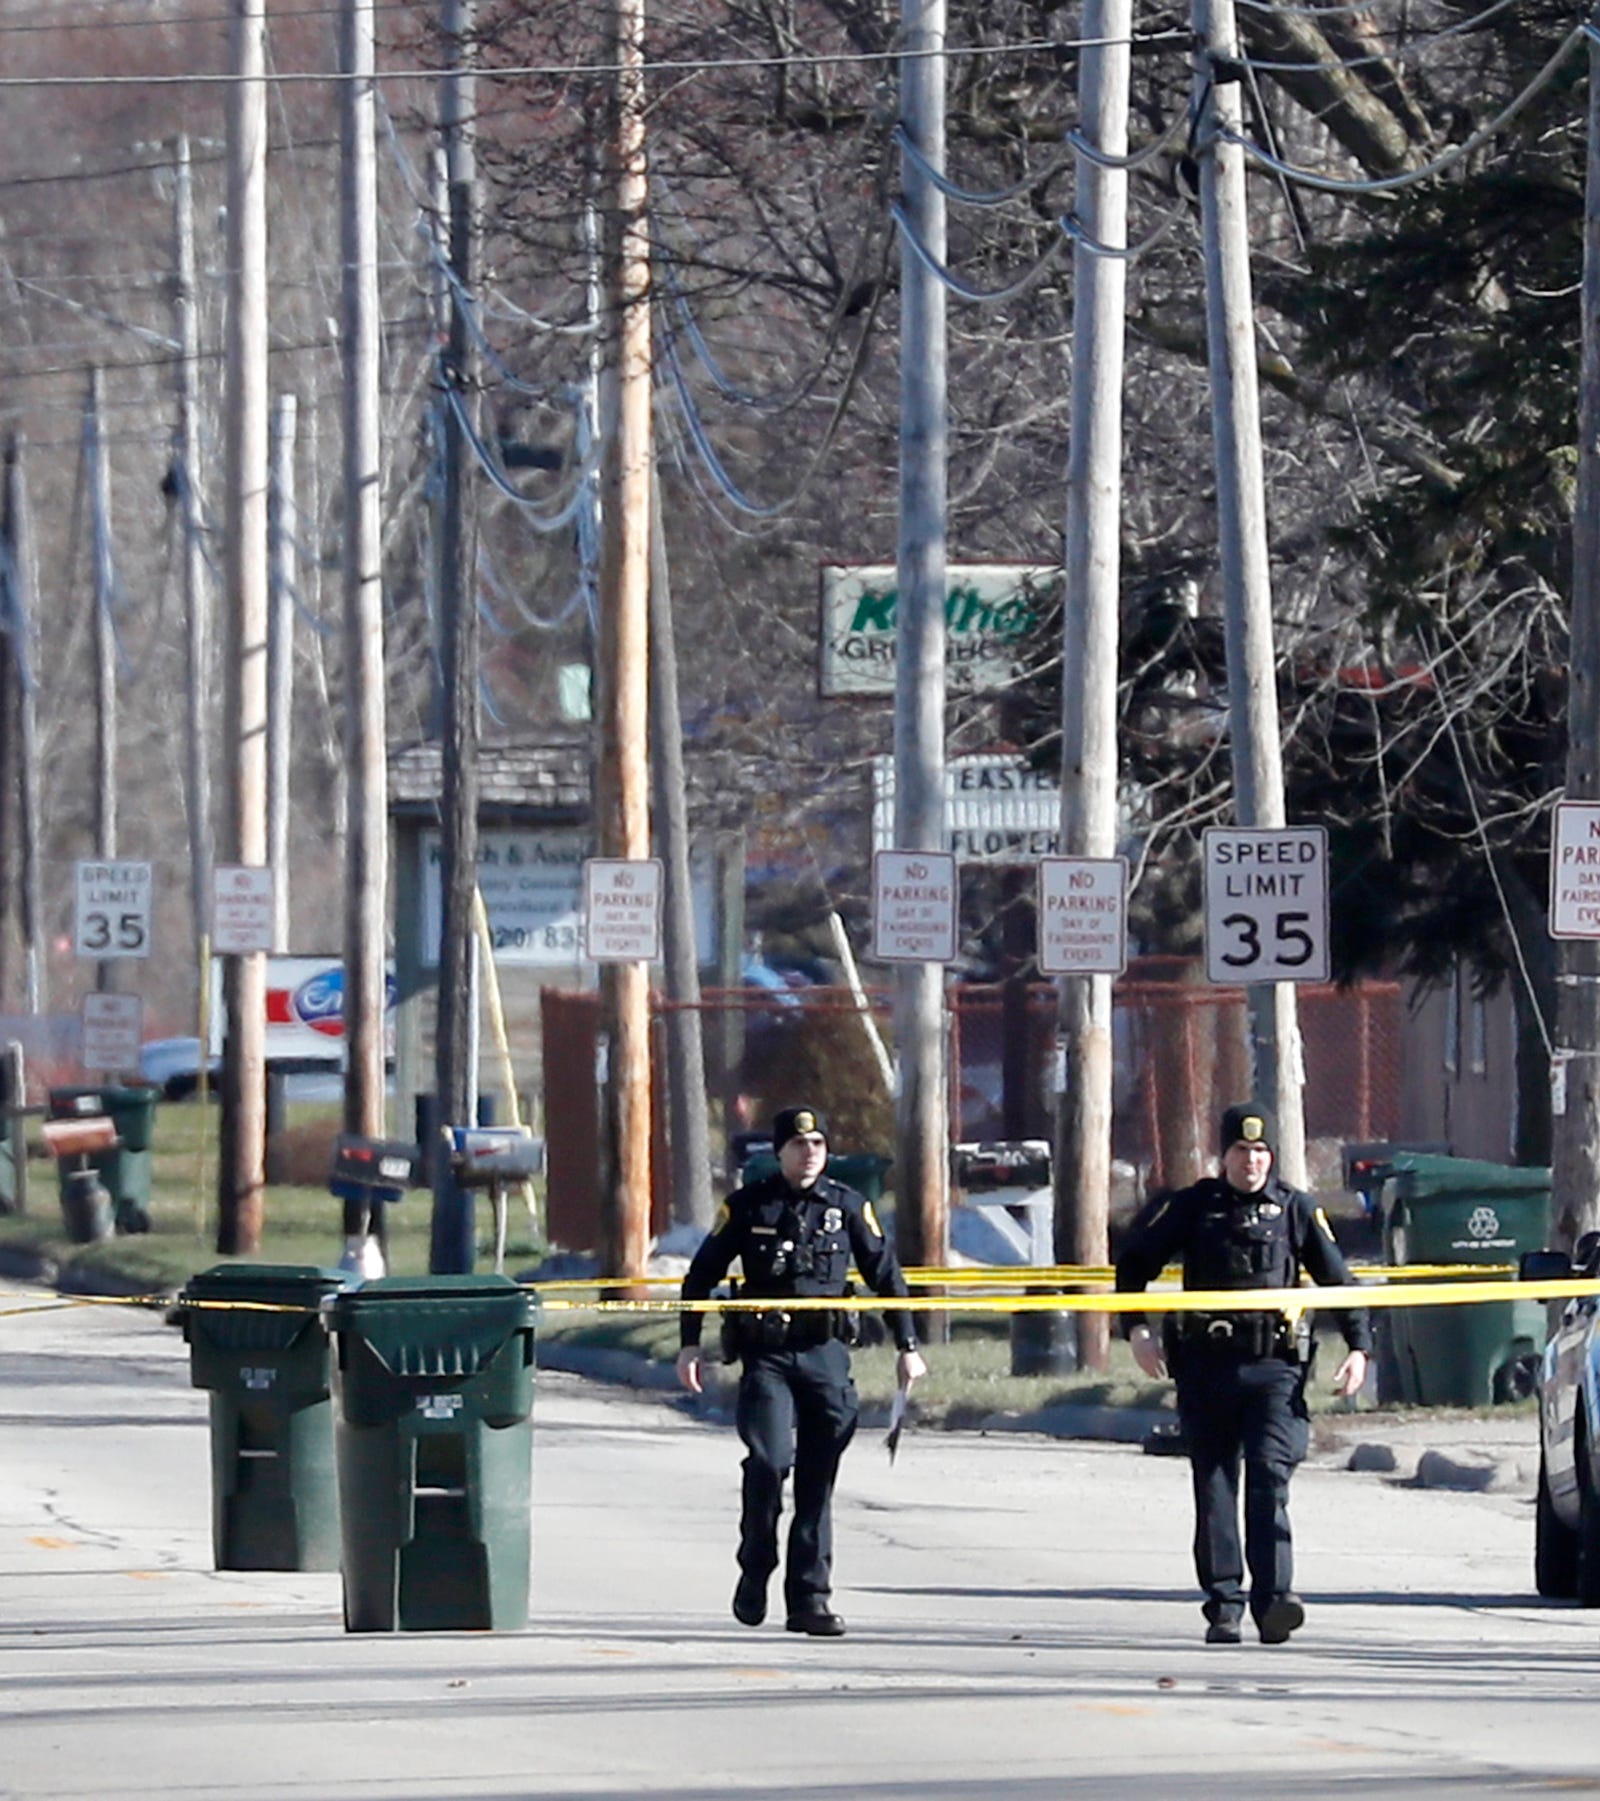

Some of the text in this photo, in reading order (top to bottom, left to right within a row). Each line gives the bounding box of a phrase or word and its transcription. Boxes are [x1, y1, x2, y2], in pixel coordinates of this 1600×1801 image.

[960, 768, 1061, 790] EASTE
[1215, 842, 1316, 864] SPEED
[613, 872, 635, 889] NO
[906, 865, 928, 880] NO
[1069, 871, 1095, 888] NO
[883, 886, 950, 902] PARKING
[1226, 874, 1305, 897] LIMIT
[89, 890, 138, 903] LIMIT
[594, 893, 654, 908] PARKING
[1048, 895, 1118, 912] PARKING
[84, 909, 144, 949] 35
[1221, 912, 1314, 967] 35
